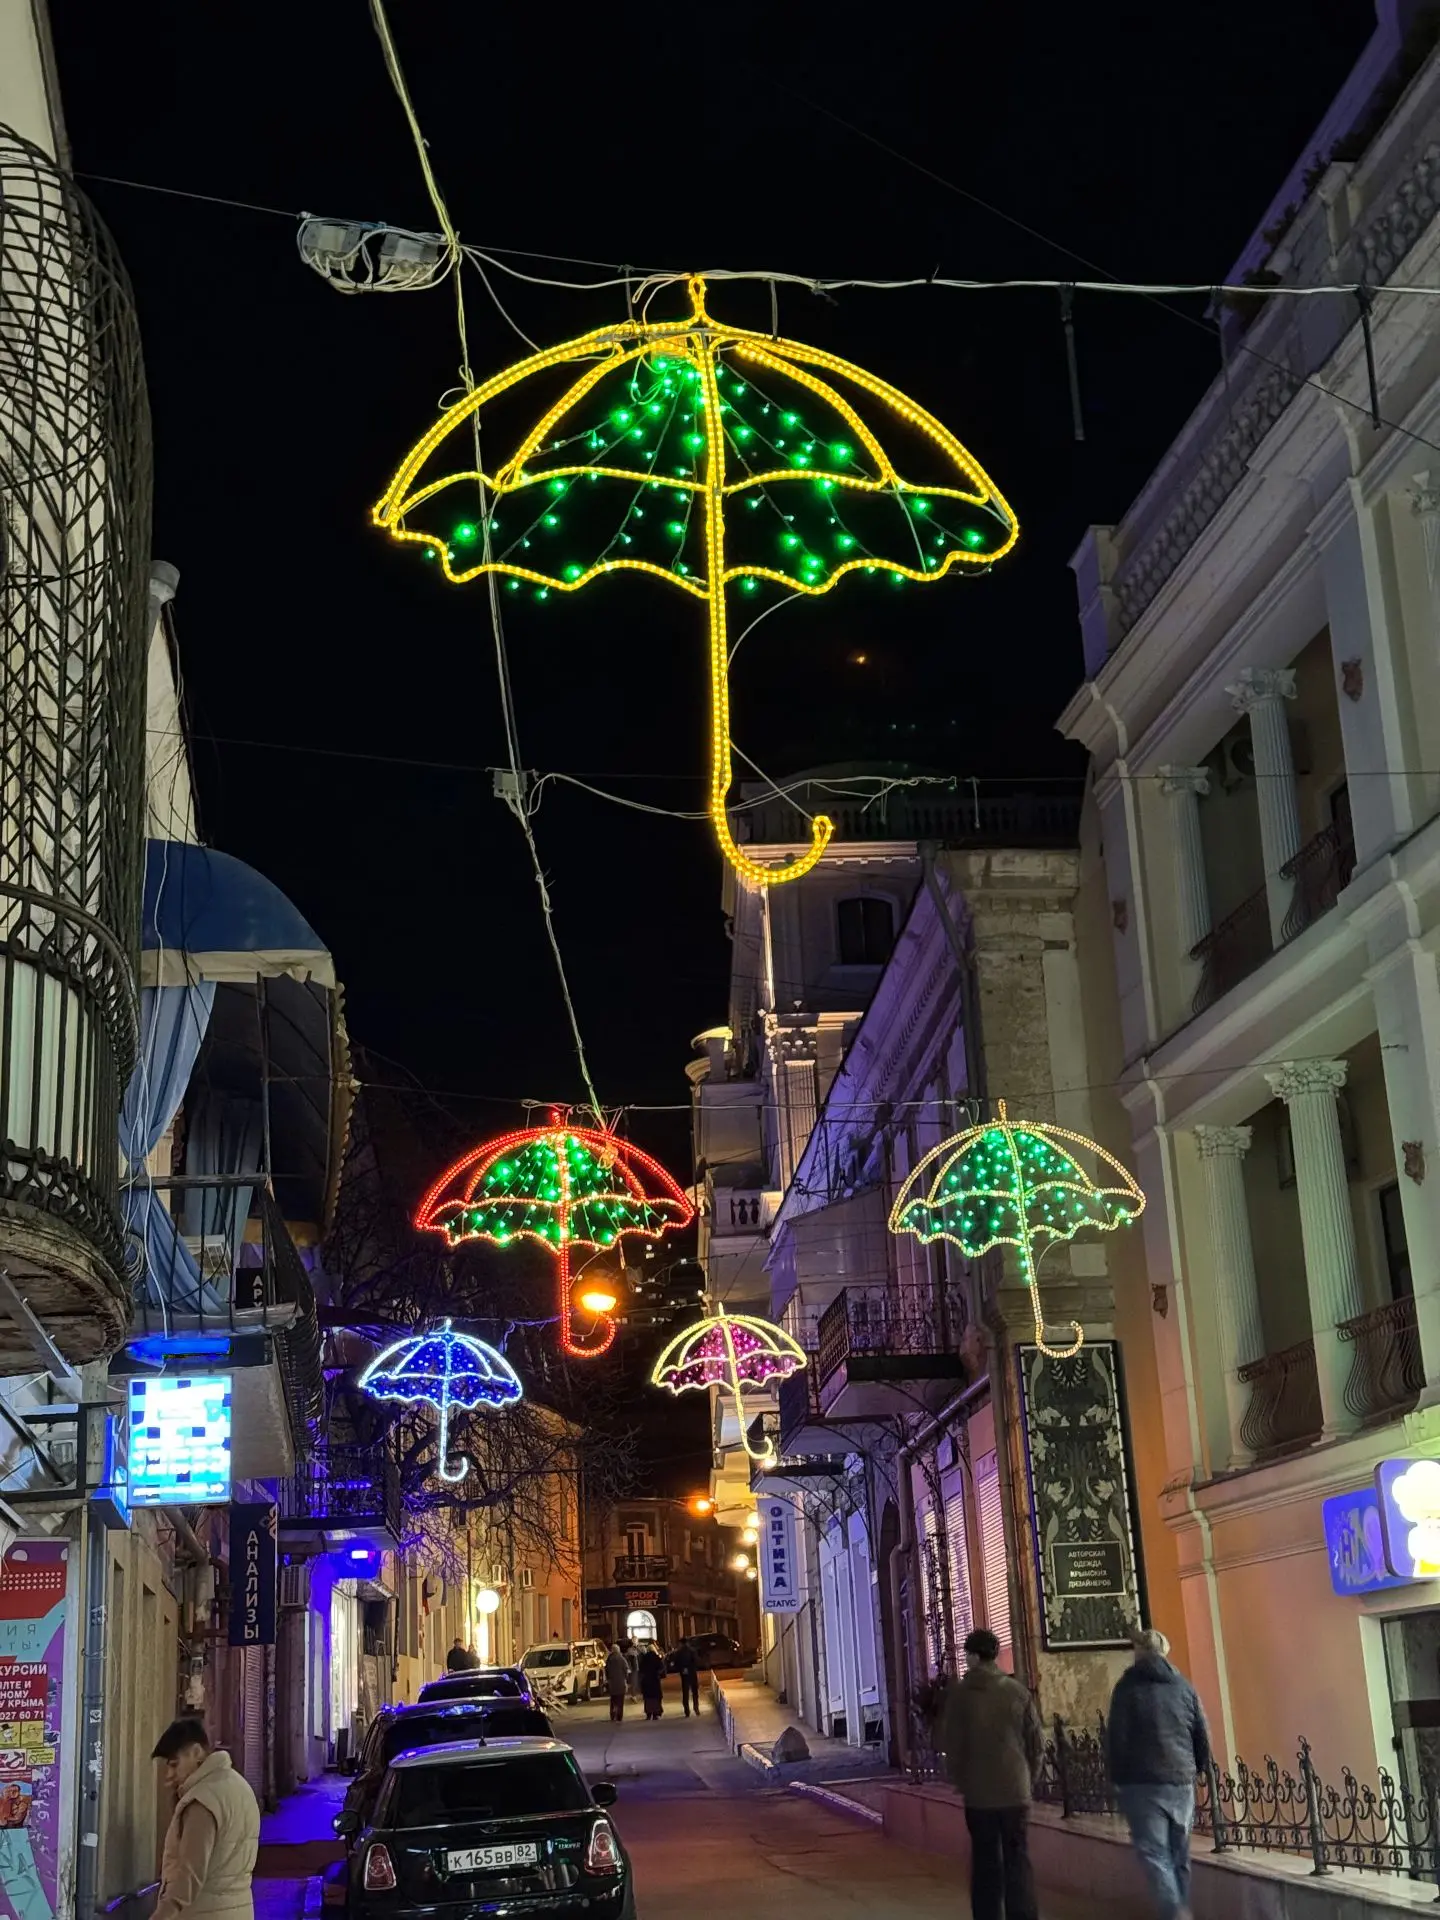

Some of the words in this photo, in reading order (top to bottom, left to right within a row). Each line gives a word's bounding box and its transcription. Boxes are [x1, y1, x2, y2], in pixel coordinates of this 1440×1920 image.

[770, 1506, 787, 1588] ОПТИКА
[1068, 1550, 1106, 1558] АВТОРСКАЯ
[1073, 1559, 1103, 1568] ОДЕЖДА
[244, 1530, 259, 1639] АНАЛИЗЫ
[1068, 1579, 1112, 1589] ДИЗАЙНЕРОВ
[624, 1591, 660, 1600] SPORT
[628, 1599, 658, 1607] STREET
[0, 1680, 21, 1690] ЛТЕ
[24, 1680, 32, 1689] И
[8, 1698, 44, 1708] КРЫМА
[19, 1711, 31, 1720] 60
[33, 1710, 44, 1719] 71
